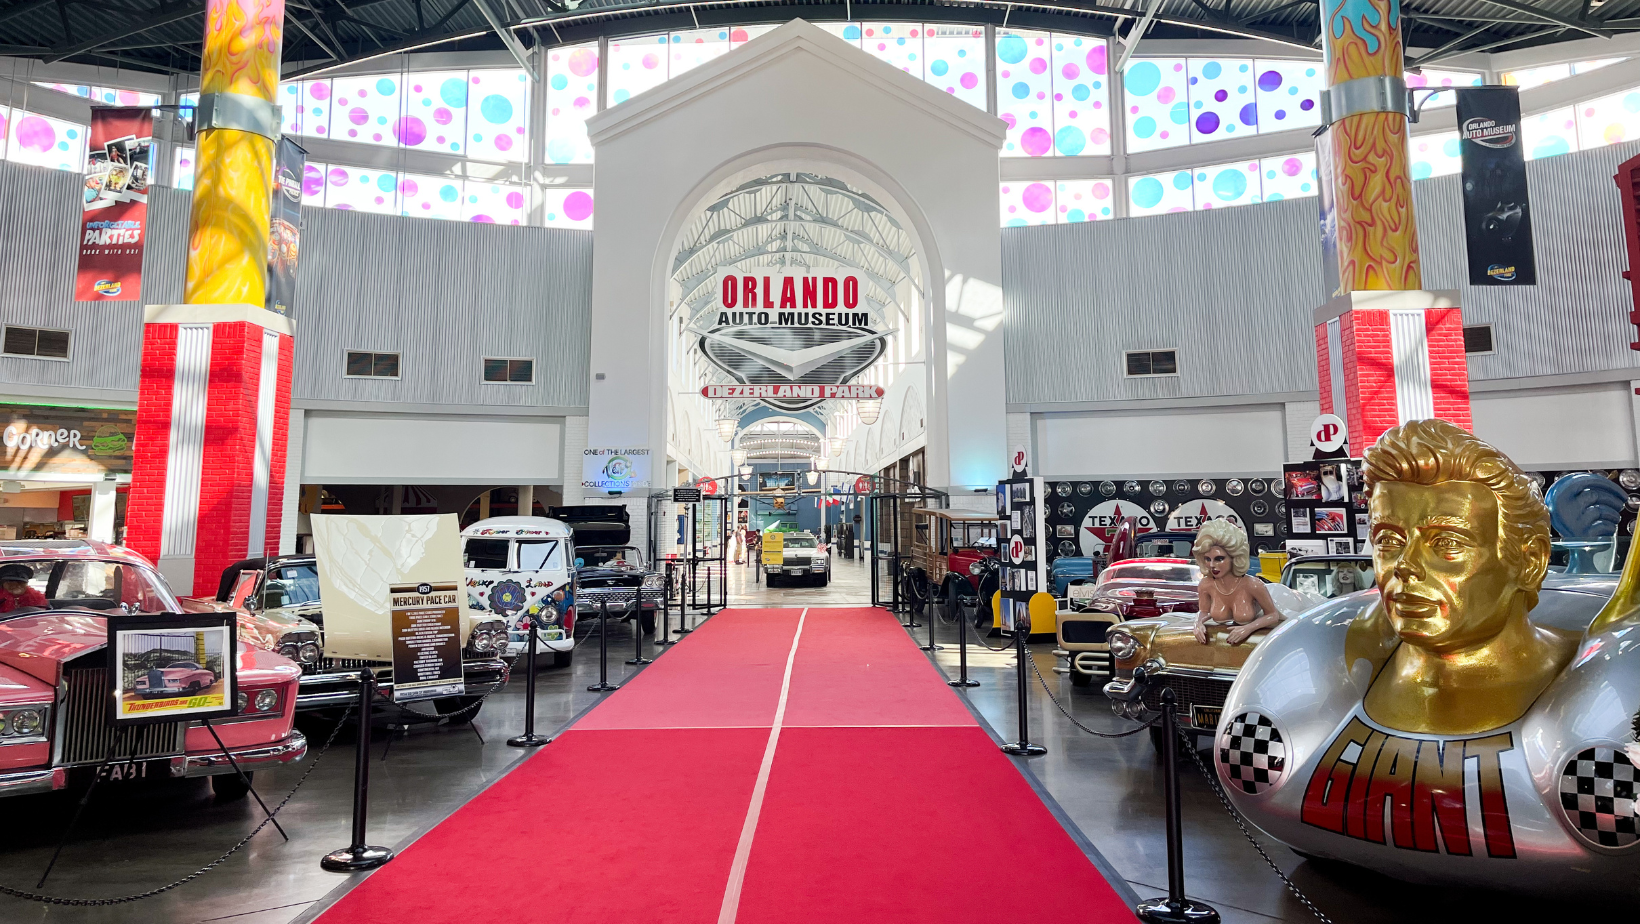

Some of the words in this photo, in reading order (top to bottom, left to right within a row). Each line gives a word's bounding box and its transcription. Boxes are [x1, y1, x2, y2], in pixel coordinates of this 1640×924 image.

[1462, 129, 1482, 139] AUTO
[1483, 124, 1516, 137] MUSEUM
[1468, 120, 1496, 130] ORLANDO
[83, 228, 141, 245] PARTIES
[722, 274, 859, 310] ORLANDO
[717, 311, 770, 326] AUTO
[778, 312, 869, 327] MUSEUM
[707, 385, 820, 398] DEZERLAND
[824, 386, 879, 399] PARK
[419, 585, 430, 593] 1957
[392, 595, 425, 607] MERCURY
[426, 594, 443, 605] PACE
[443, 594, 457, 604] CAR
[1300, 714, 1518, 860] GIANT
